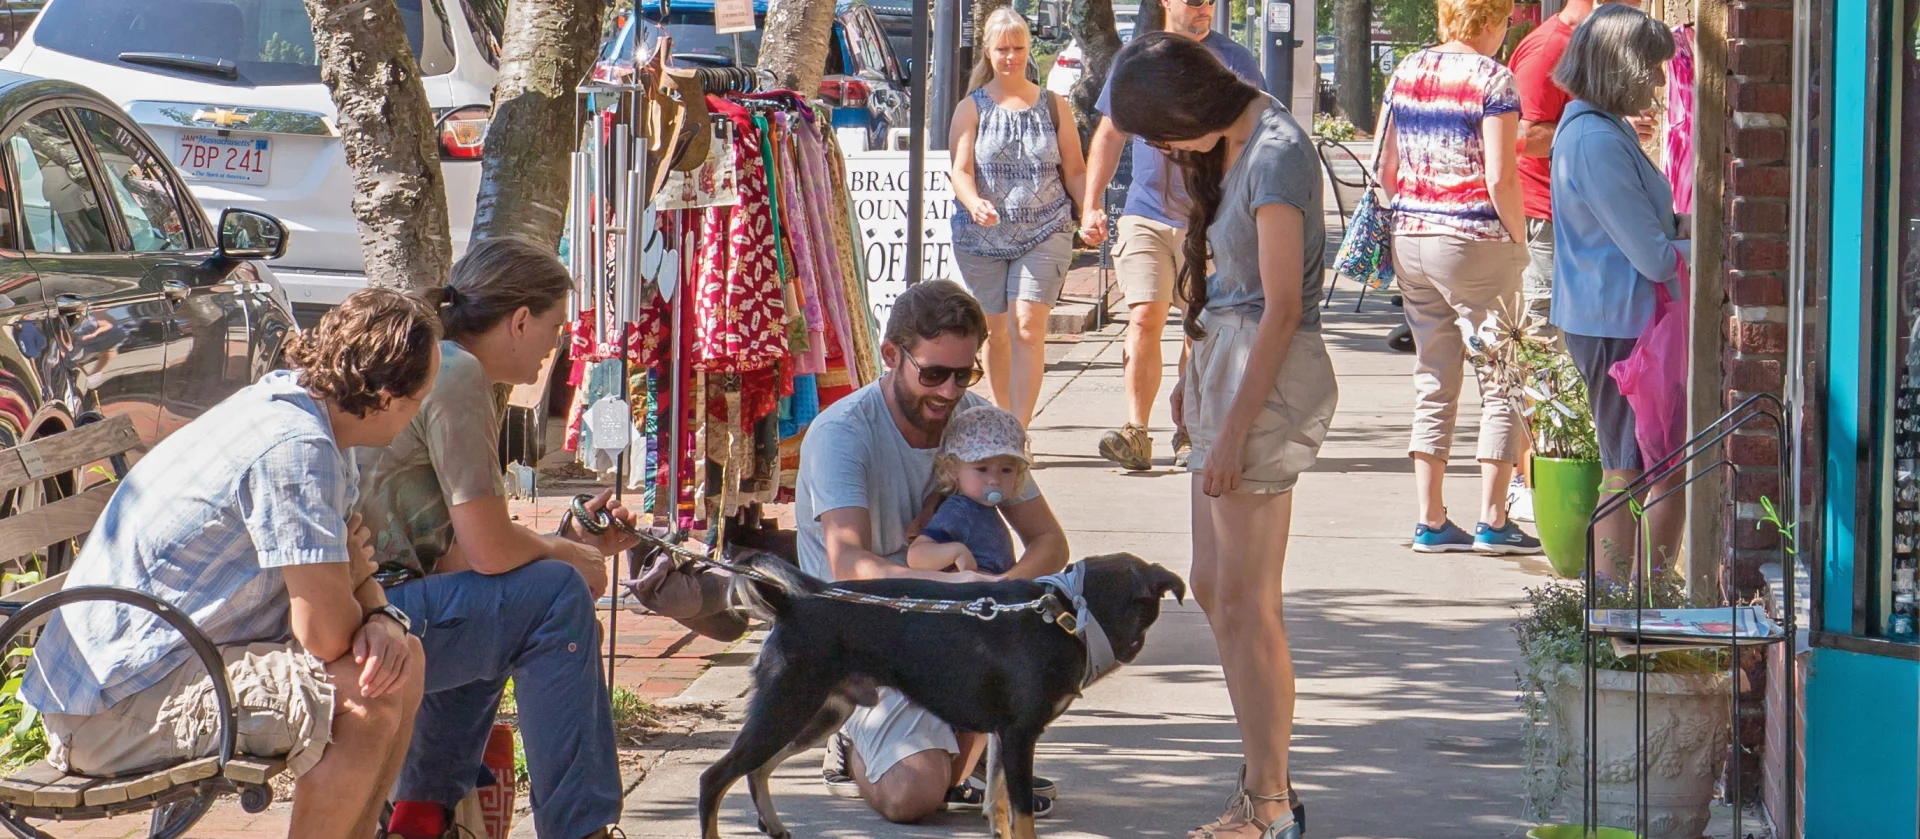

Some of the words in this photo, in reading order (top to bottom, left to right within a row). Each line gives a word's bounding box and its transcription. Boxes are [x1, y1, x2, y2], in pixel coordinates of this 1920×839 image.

[181, 134, 195, 142] JAN
[198, 135, 251, 147] Massachusetts
[180, 143, 220, 169] 7BP
[225, 147, 263, 173] 241
[851, 170, 953, 192] BRACEN
